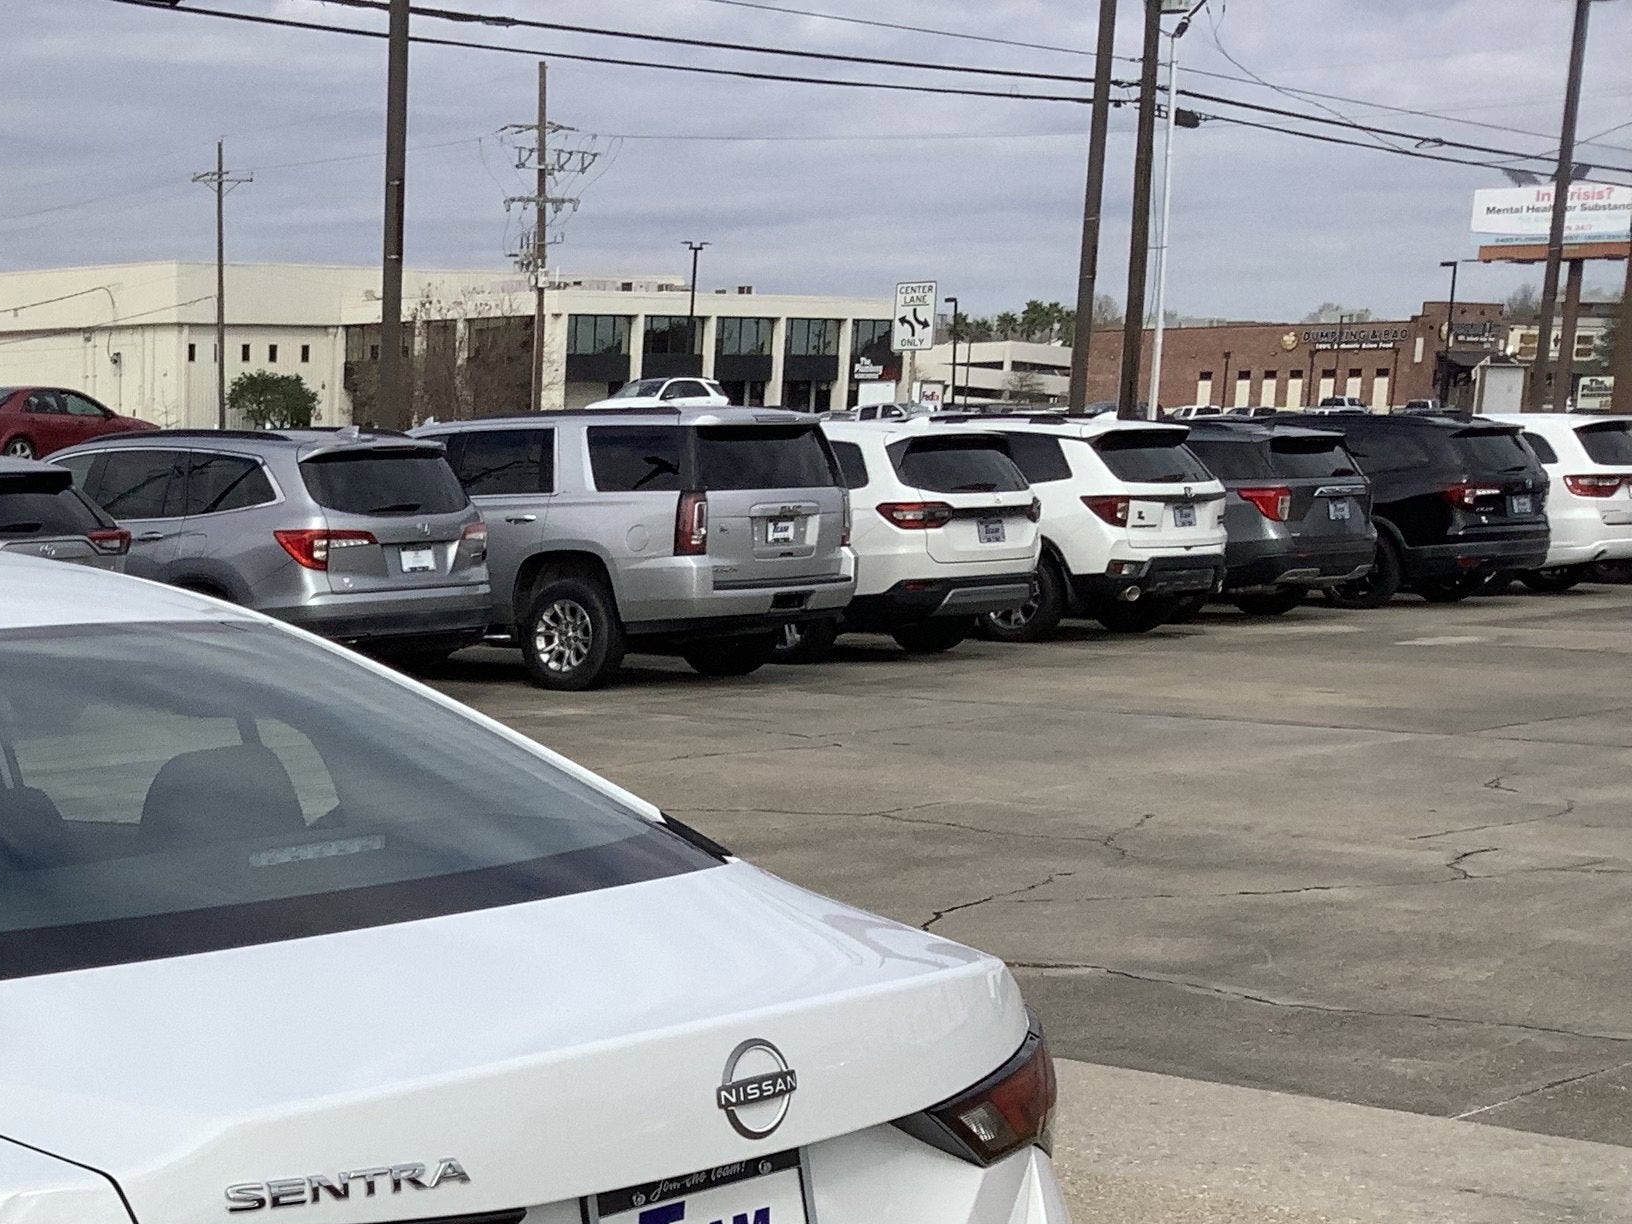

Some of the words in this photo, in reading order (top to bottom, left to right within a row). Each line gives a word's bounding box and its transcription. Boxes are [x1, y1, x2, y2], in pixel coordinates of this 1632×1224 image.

[1536, 189, 1552, 203] In
[1569, 186, 1615, 201] risis?
[1485, 205, 1523, 216] Mental
[1526, 204, 1553, 214] Heal
[1580, 203, 1632, 212] Substanc
[899, 284, 934, 295] CENTER
[904, 294, 928, 304] LANE
[1303, 329, 1366, 342] DUMPING
[900, 338, 925, 348] ONLY
[720, 1075, 796, 1105] NISSAN
[224, 1157, 470, 1213] SENTRA
